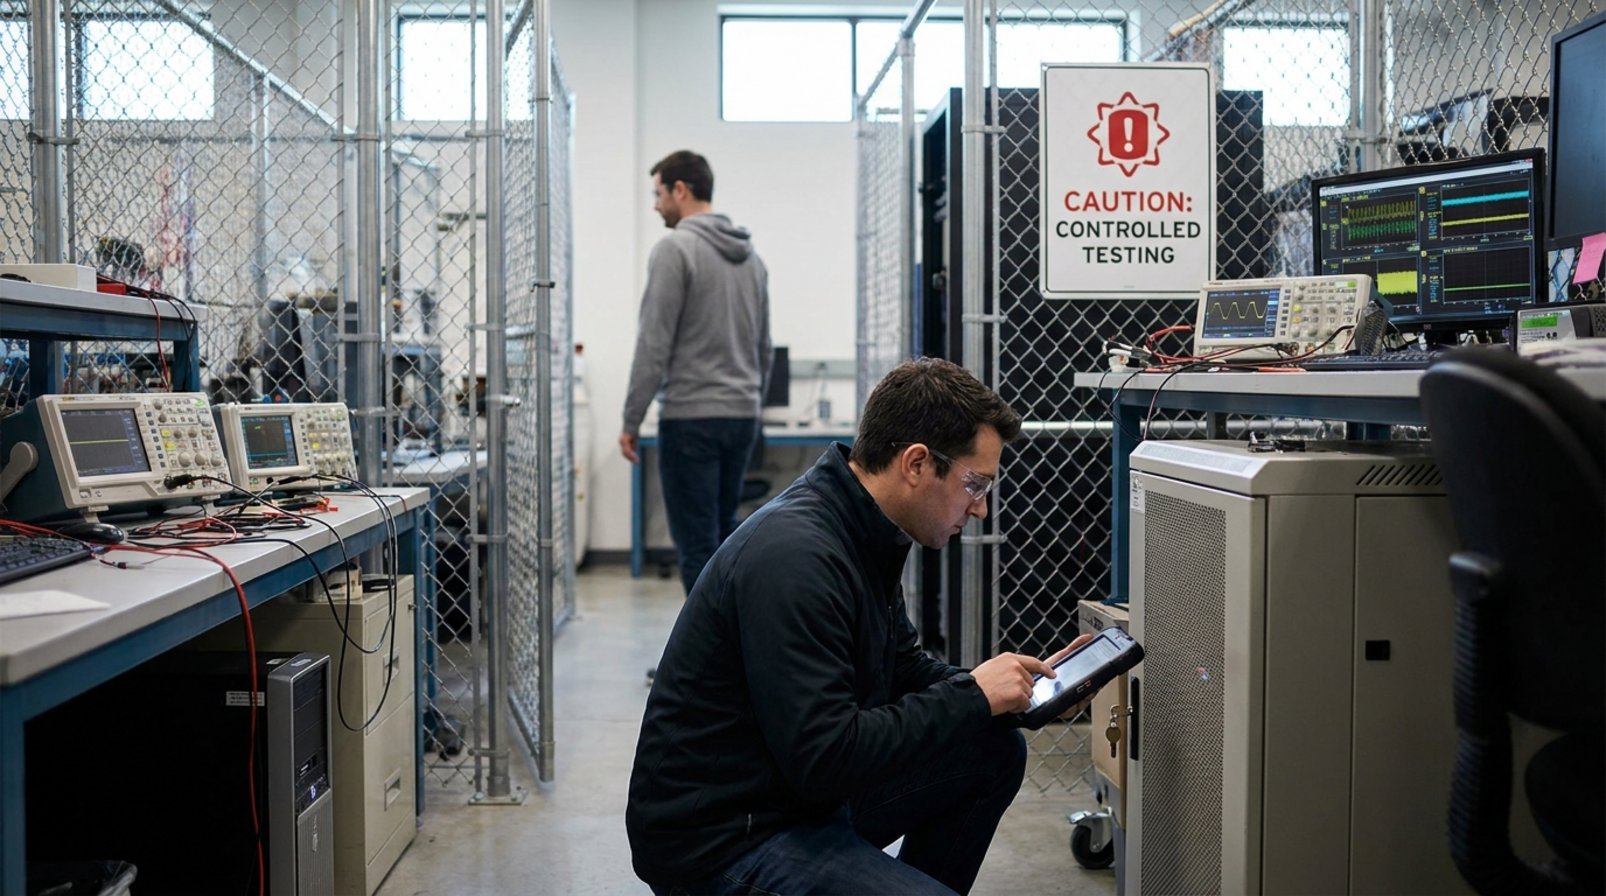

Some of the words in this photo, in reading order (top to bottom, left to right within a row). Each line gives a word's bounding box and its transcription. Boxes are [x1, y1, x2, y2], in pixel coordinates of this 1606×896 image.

[1065, 191, 1192, 212] CAUTION:
[1056, 221, 1201, 238] CONTROLLED
[1082, 247, 1175, 264] TESTING
